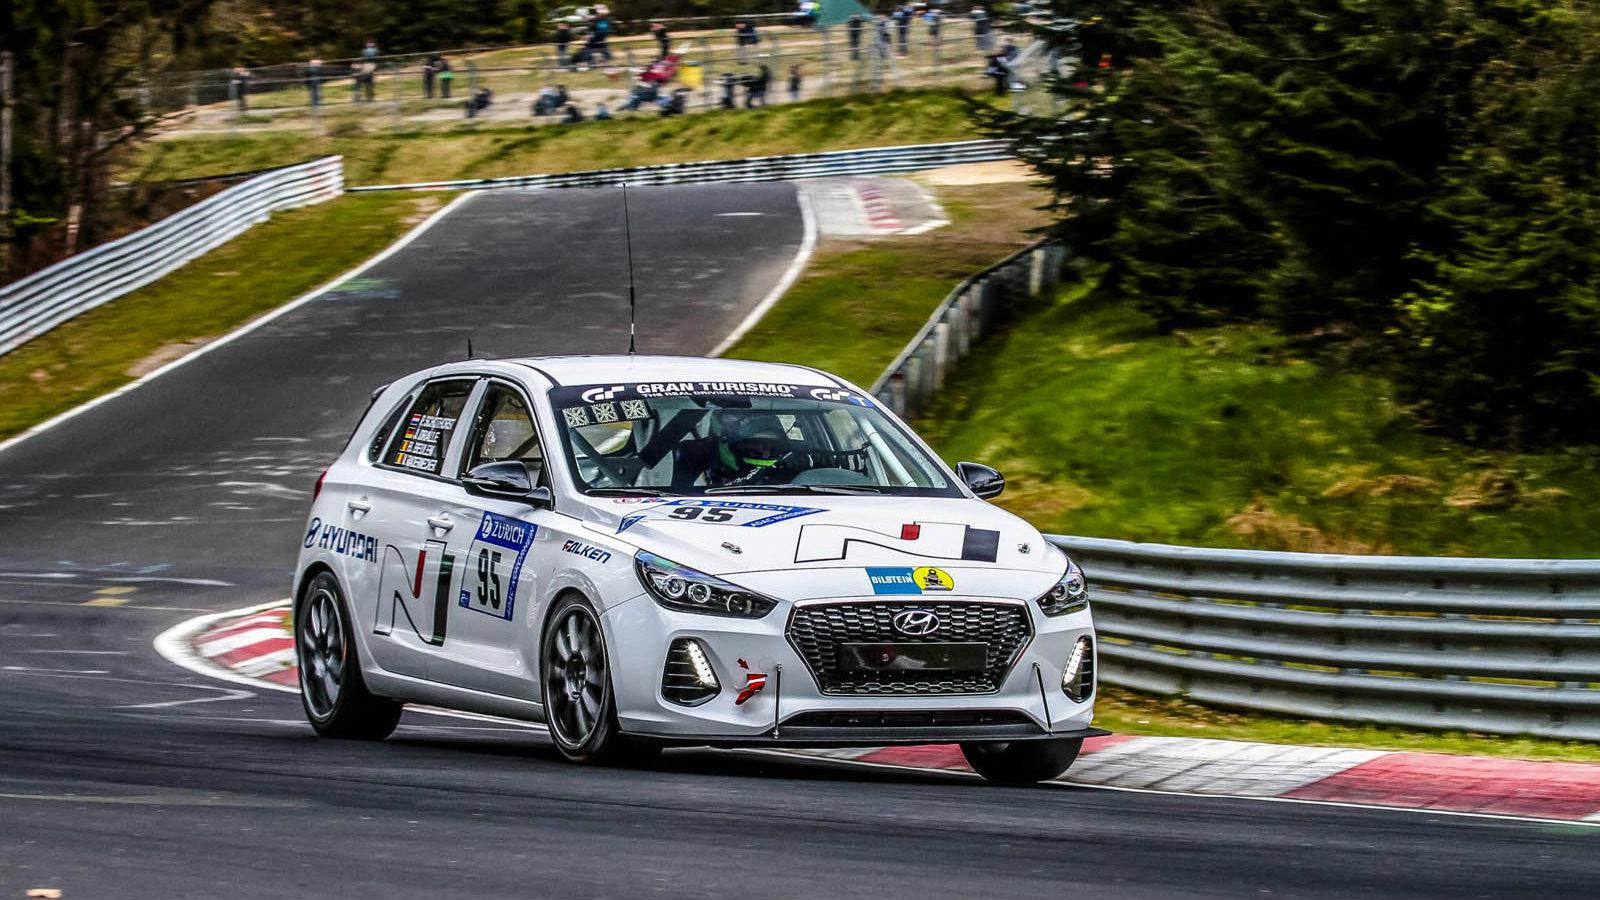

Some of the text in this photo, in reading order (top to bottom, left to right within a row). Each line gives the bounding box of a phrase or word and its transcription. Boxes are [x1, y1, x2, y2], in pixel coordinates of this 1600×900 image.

[636, 382, 791, 394] GRAN TURISMO
[736, 390, 795, 398] SIMULATOR
[668, 506, 738, 522] 95
[706, 502, 793, 512] ZURICH
[491, 521, 526, 544] ZURICH
[318, 524, 379, 564] HYUNDAI
[561, 540, 612, 564] FALKEN
[477, 547, 502, 610] 95
[870, 575, 914, 584] BILSTEIN
